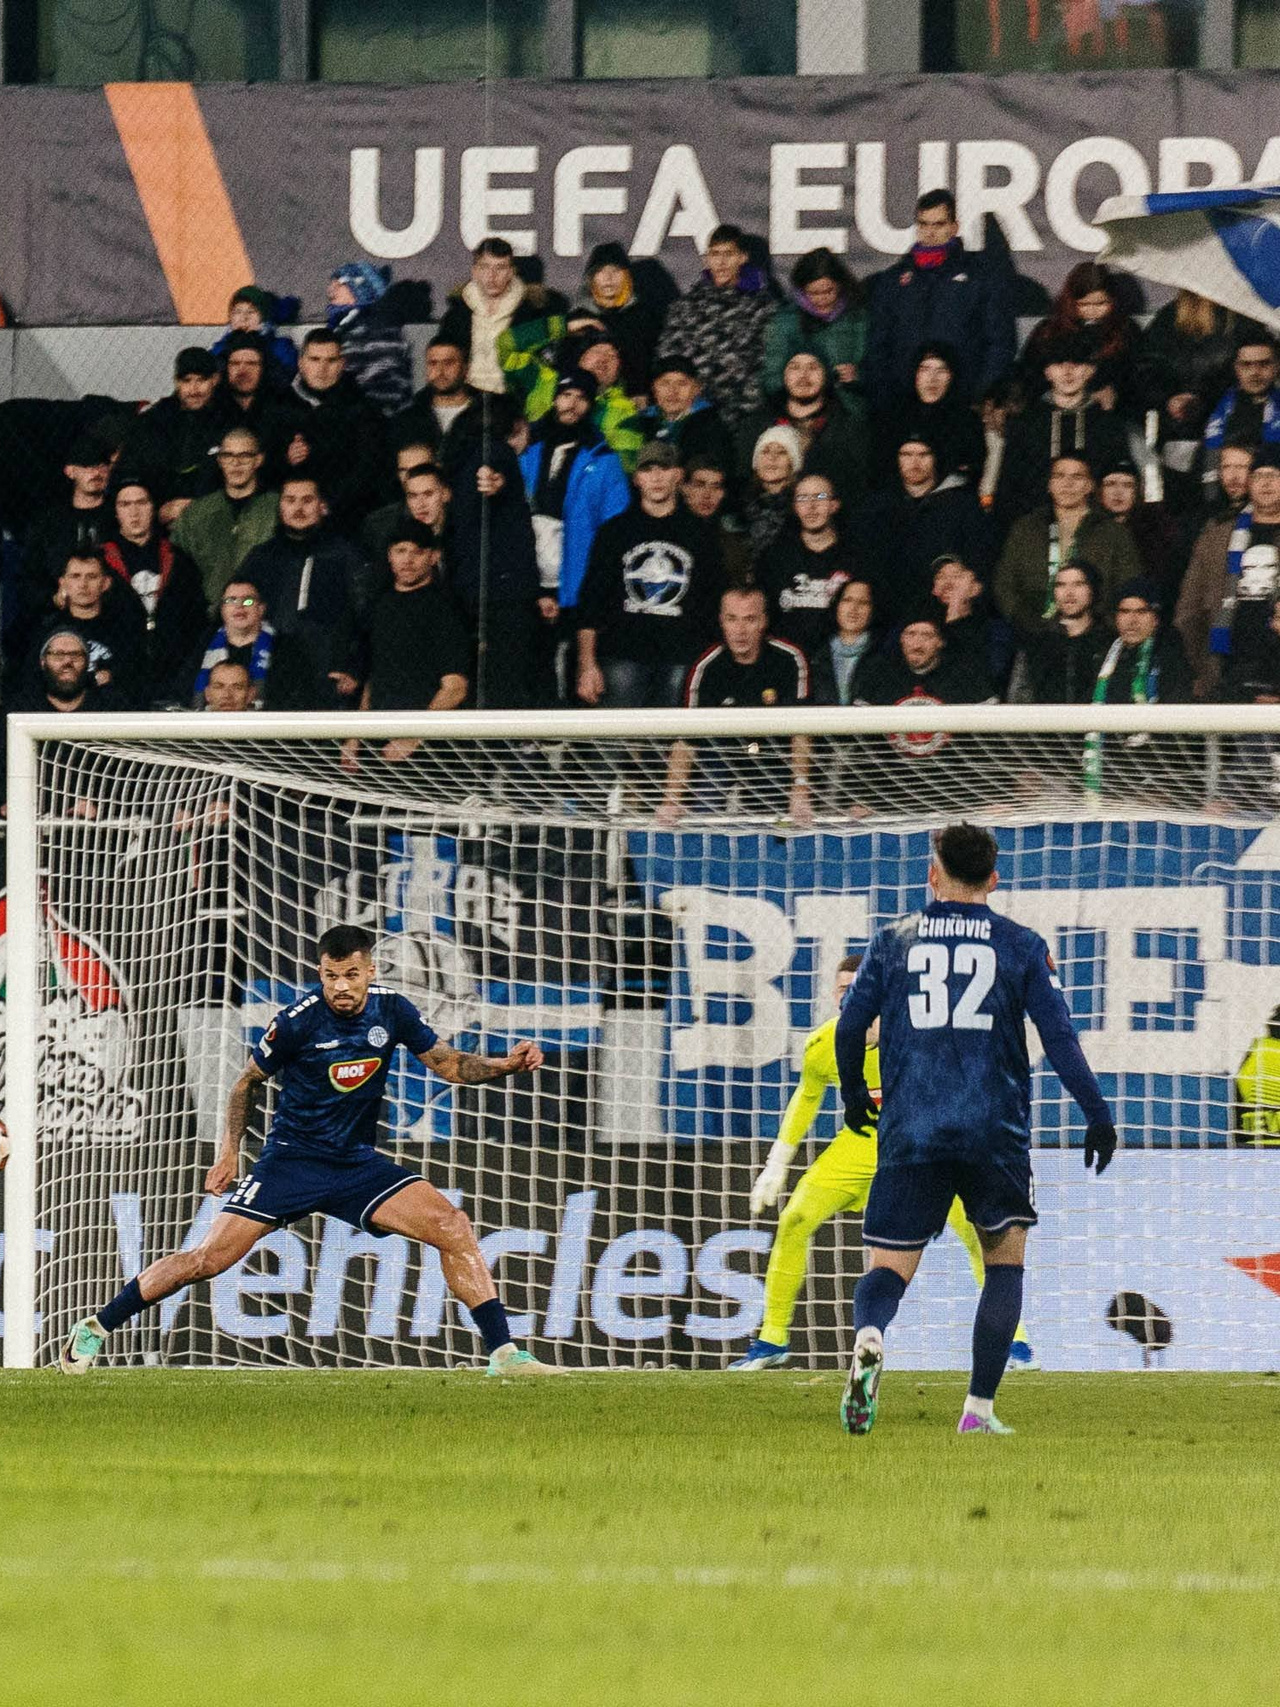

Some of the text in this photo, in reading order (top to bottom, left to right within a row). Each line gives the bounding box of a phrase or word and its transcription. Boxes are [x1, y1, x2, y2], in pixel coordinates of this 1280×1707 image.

[349, 143, 721, 259] UEFA
[907, 943, 997, 1031] 32
[336, 1064, 366, 1079] MOL
[111, 1188, 774, 1341] Vehicles
